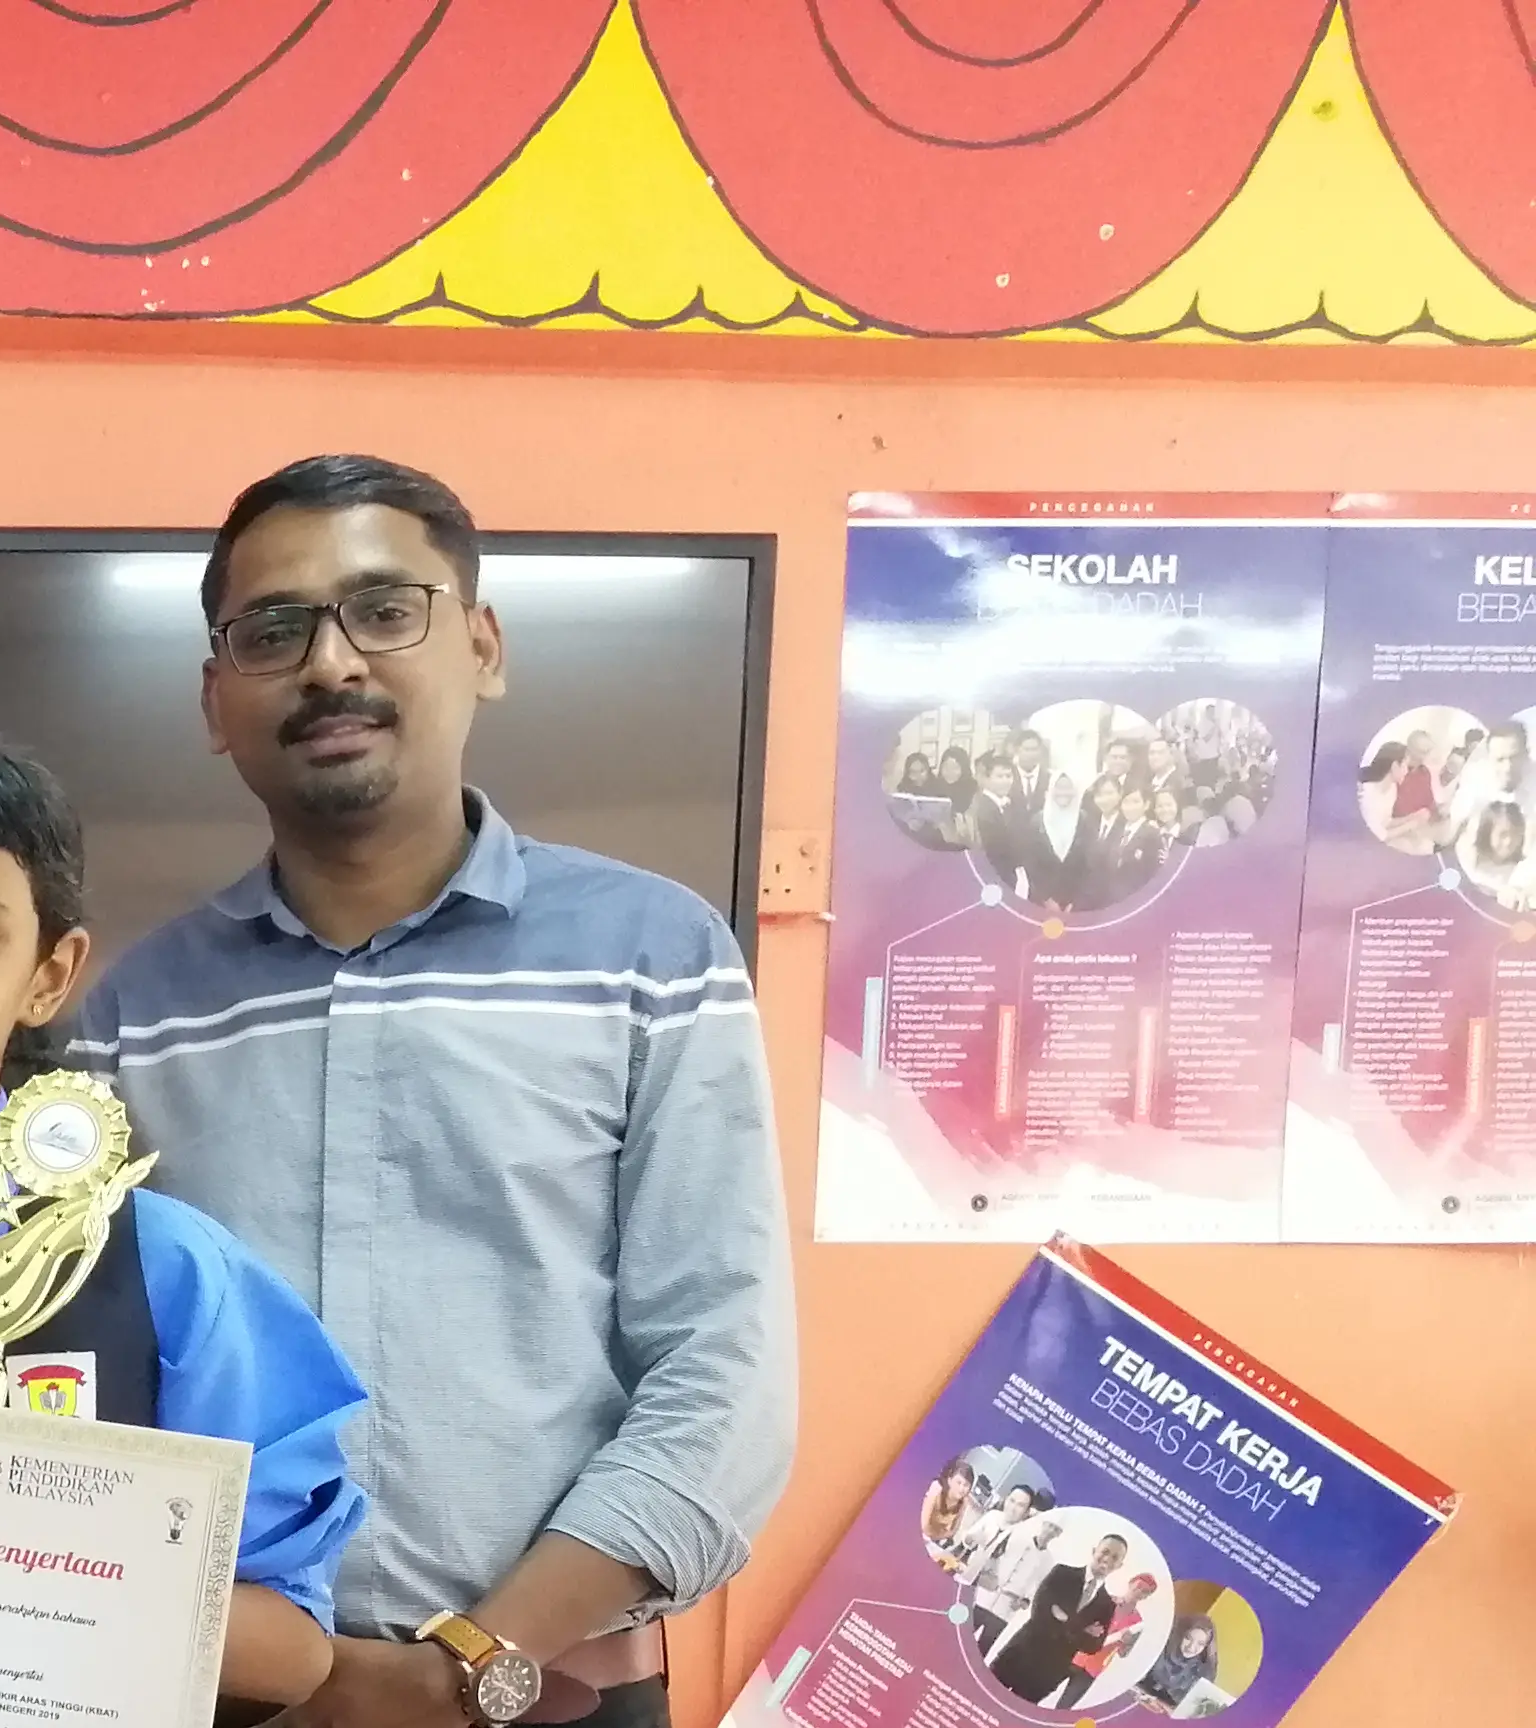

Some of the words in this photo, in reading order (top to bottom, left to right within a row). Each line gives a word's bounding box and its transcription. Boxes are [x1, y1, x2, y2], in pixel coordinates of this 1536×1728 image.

[1007, 554, 1177, 584] SEKOLAH
[1192, 1332, 1299, 1407] PENCEGAHAN
[1098, 1335, 1223, 1431] TEMPAT
[1215, 1419, 1322, 1506] KERJA
[1090, 1376, 1186, 1454] BEBAS
[1181, 1440, 1287, 1522] DADAH
[8, 1467, 114, 1494] PENDIDIKAN
[10, 1454, 134, 1484] KEMENTERIAN
[8, 1481, 93, 1506] MALAYSIA
[19, 1695, 46, 1706] ARAS
[50, 1699, 83, 1711] TINGGI
[84, 1706, 118, 1719] (KBAT)
[37, 1709, 59, 1720] 2019
